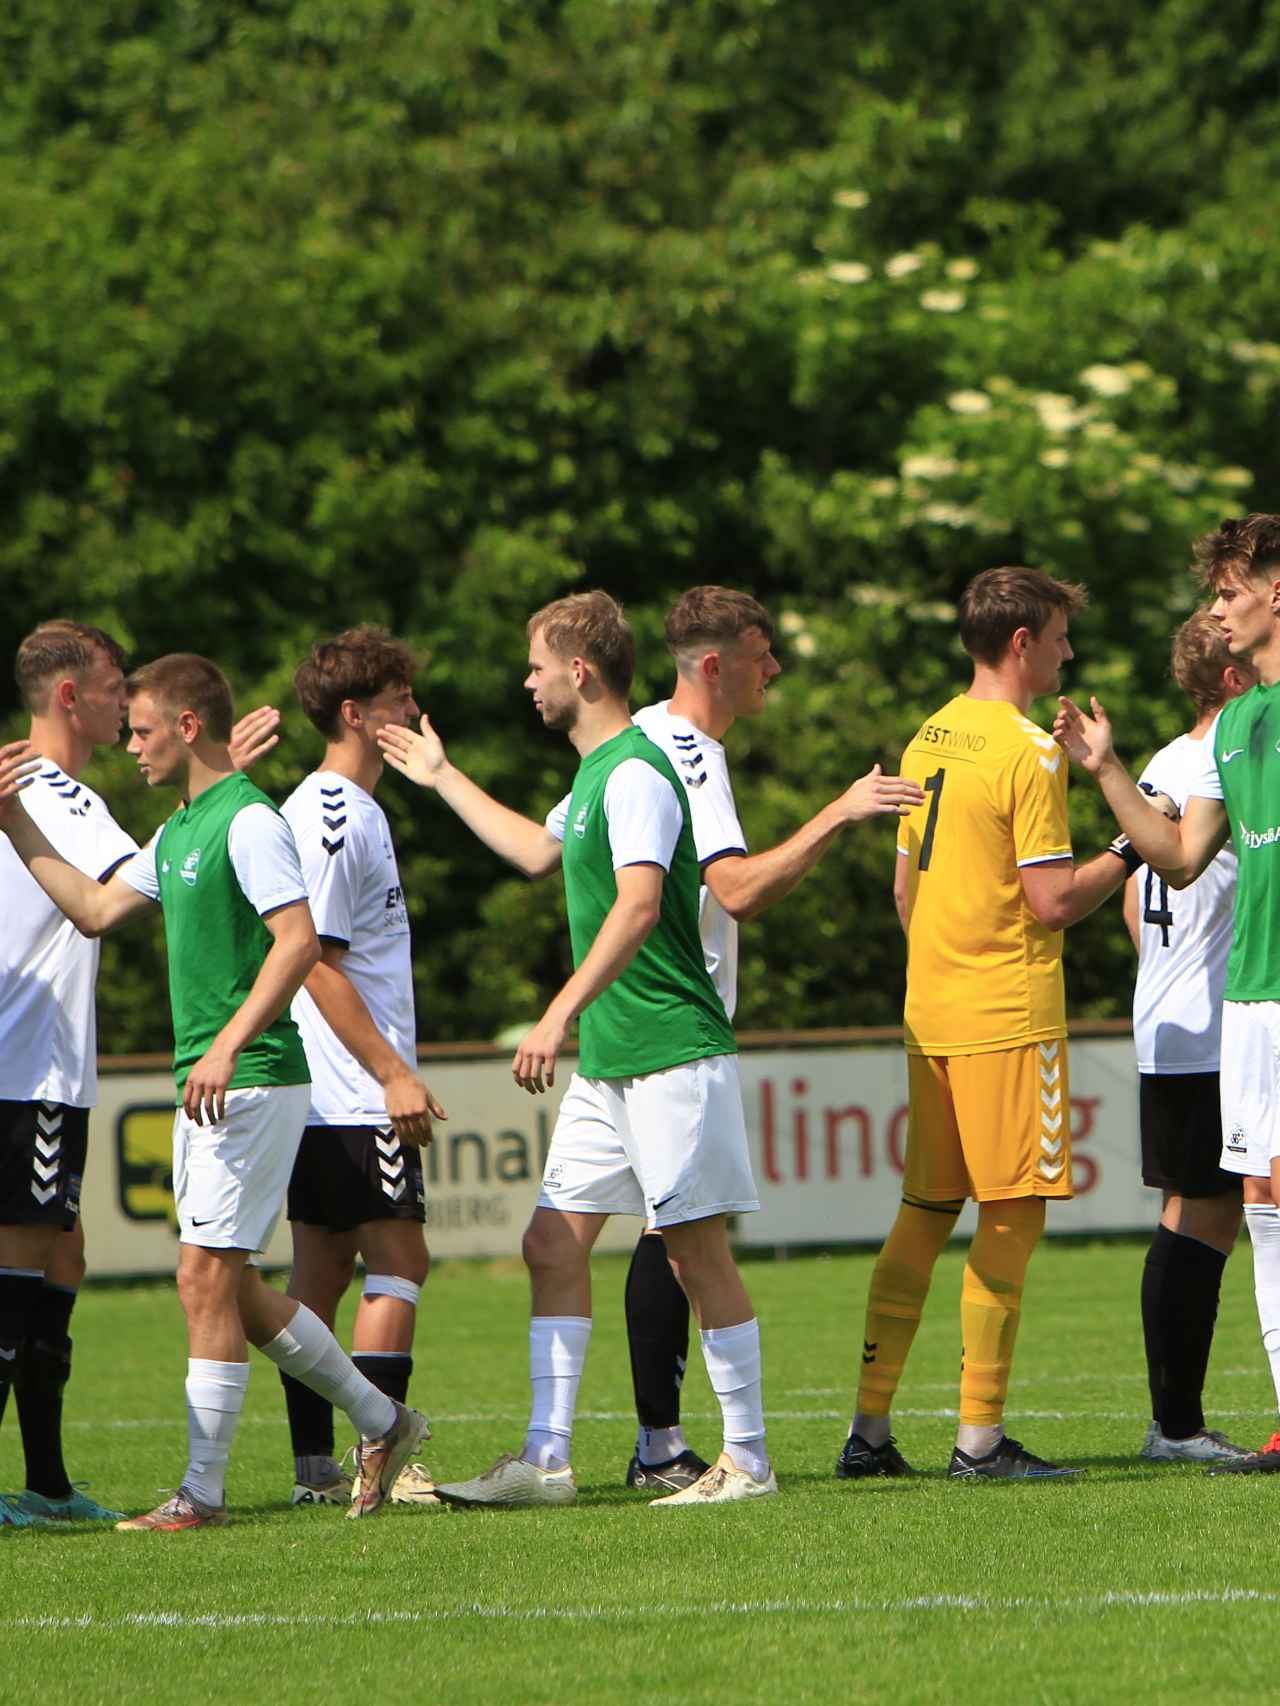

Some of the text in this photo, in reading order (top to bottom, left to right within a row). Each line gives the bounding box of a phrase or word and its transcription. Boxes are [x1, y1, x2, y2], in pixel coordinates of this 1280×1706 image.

[918, 767, 946, 871] 1
[1144, 864, 1173, 948] 4
[427, 1106, 549, 1184] inal
